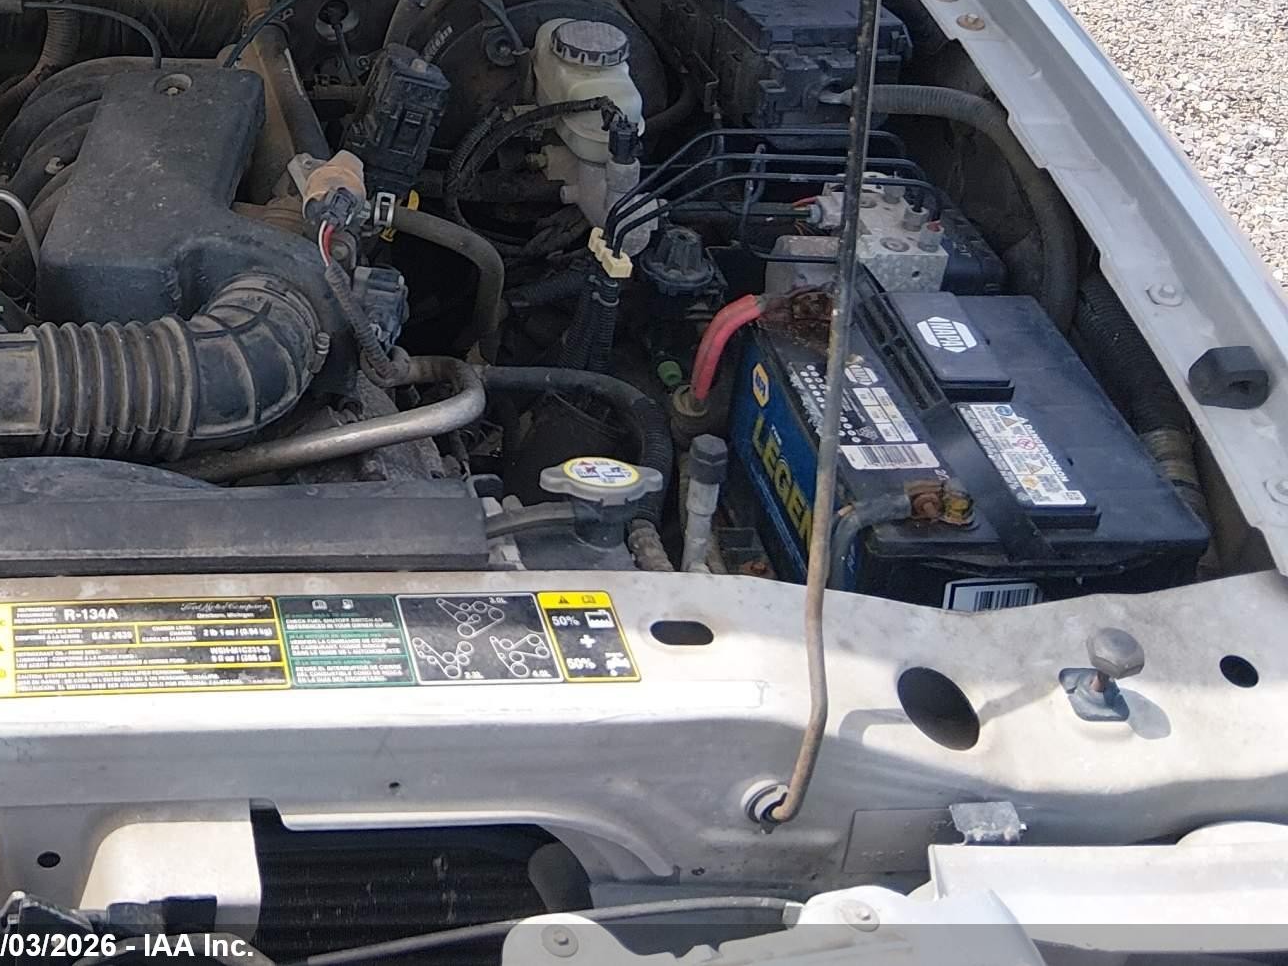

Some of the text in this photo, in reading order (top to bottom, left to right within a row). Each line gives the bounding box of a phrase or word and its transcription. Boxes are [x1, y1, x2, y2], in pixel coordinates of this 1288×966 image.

[752, 412, 813, 554] LEGEN
[63, 607, 119, 621] R-134A
[551, 615, 581, 626] 50%
[203, 628, 209, 637] 2
[209, 628, 218, 637] lb
[258, 627, 273, 637] kg)
[565, 657, 597, 670] 50%
